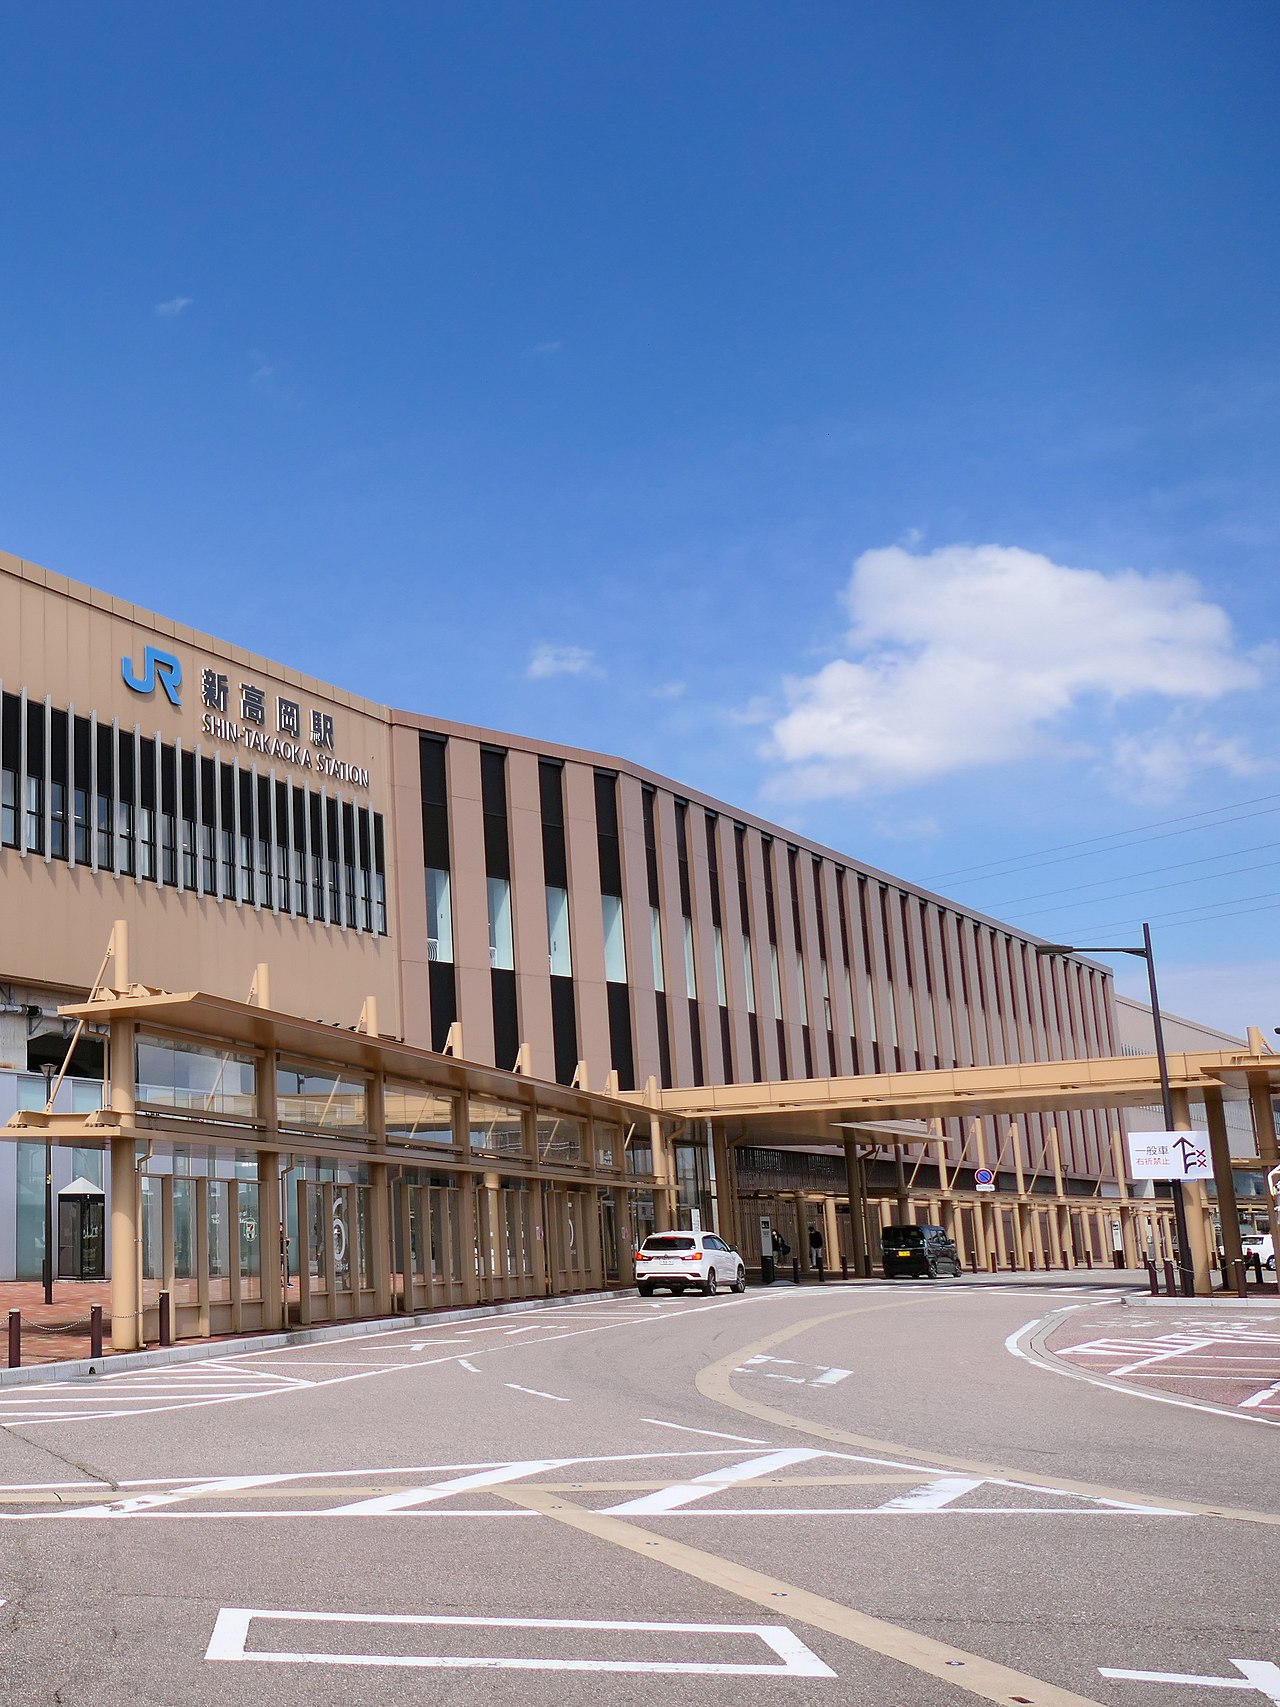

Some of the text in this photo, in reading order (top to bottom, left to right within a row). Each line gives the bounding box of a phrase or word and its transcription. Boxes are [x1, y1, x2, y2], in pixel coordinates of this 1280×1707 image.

[122, 645, 183, 706] JR
[201, 667, 335, 750] 新高岡駅
[201, 713, 370, 788] SHIN-TAKAOKA STATION
[1135, 1145, 1169, 1156] 一般車
[1136, 1157, 1171, 1166] 右折禁止
